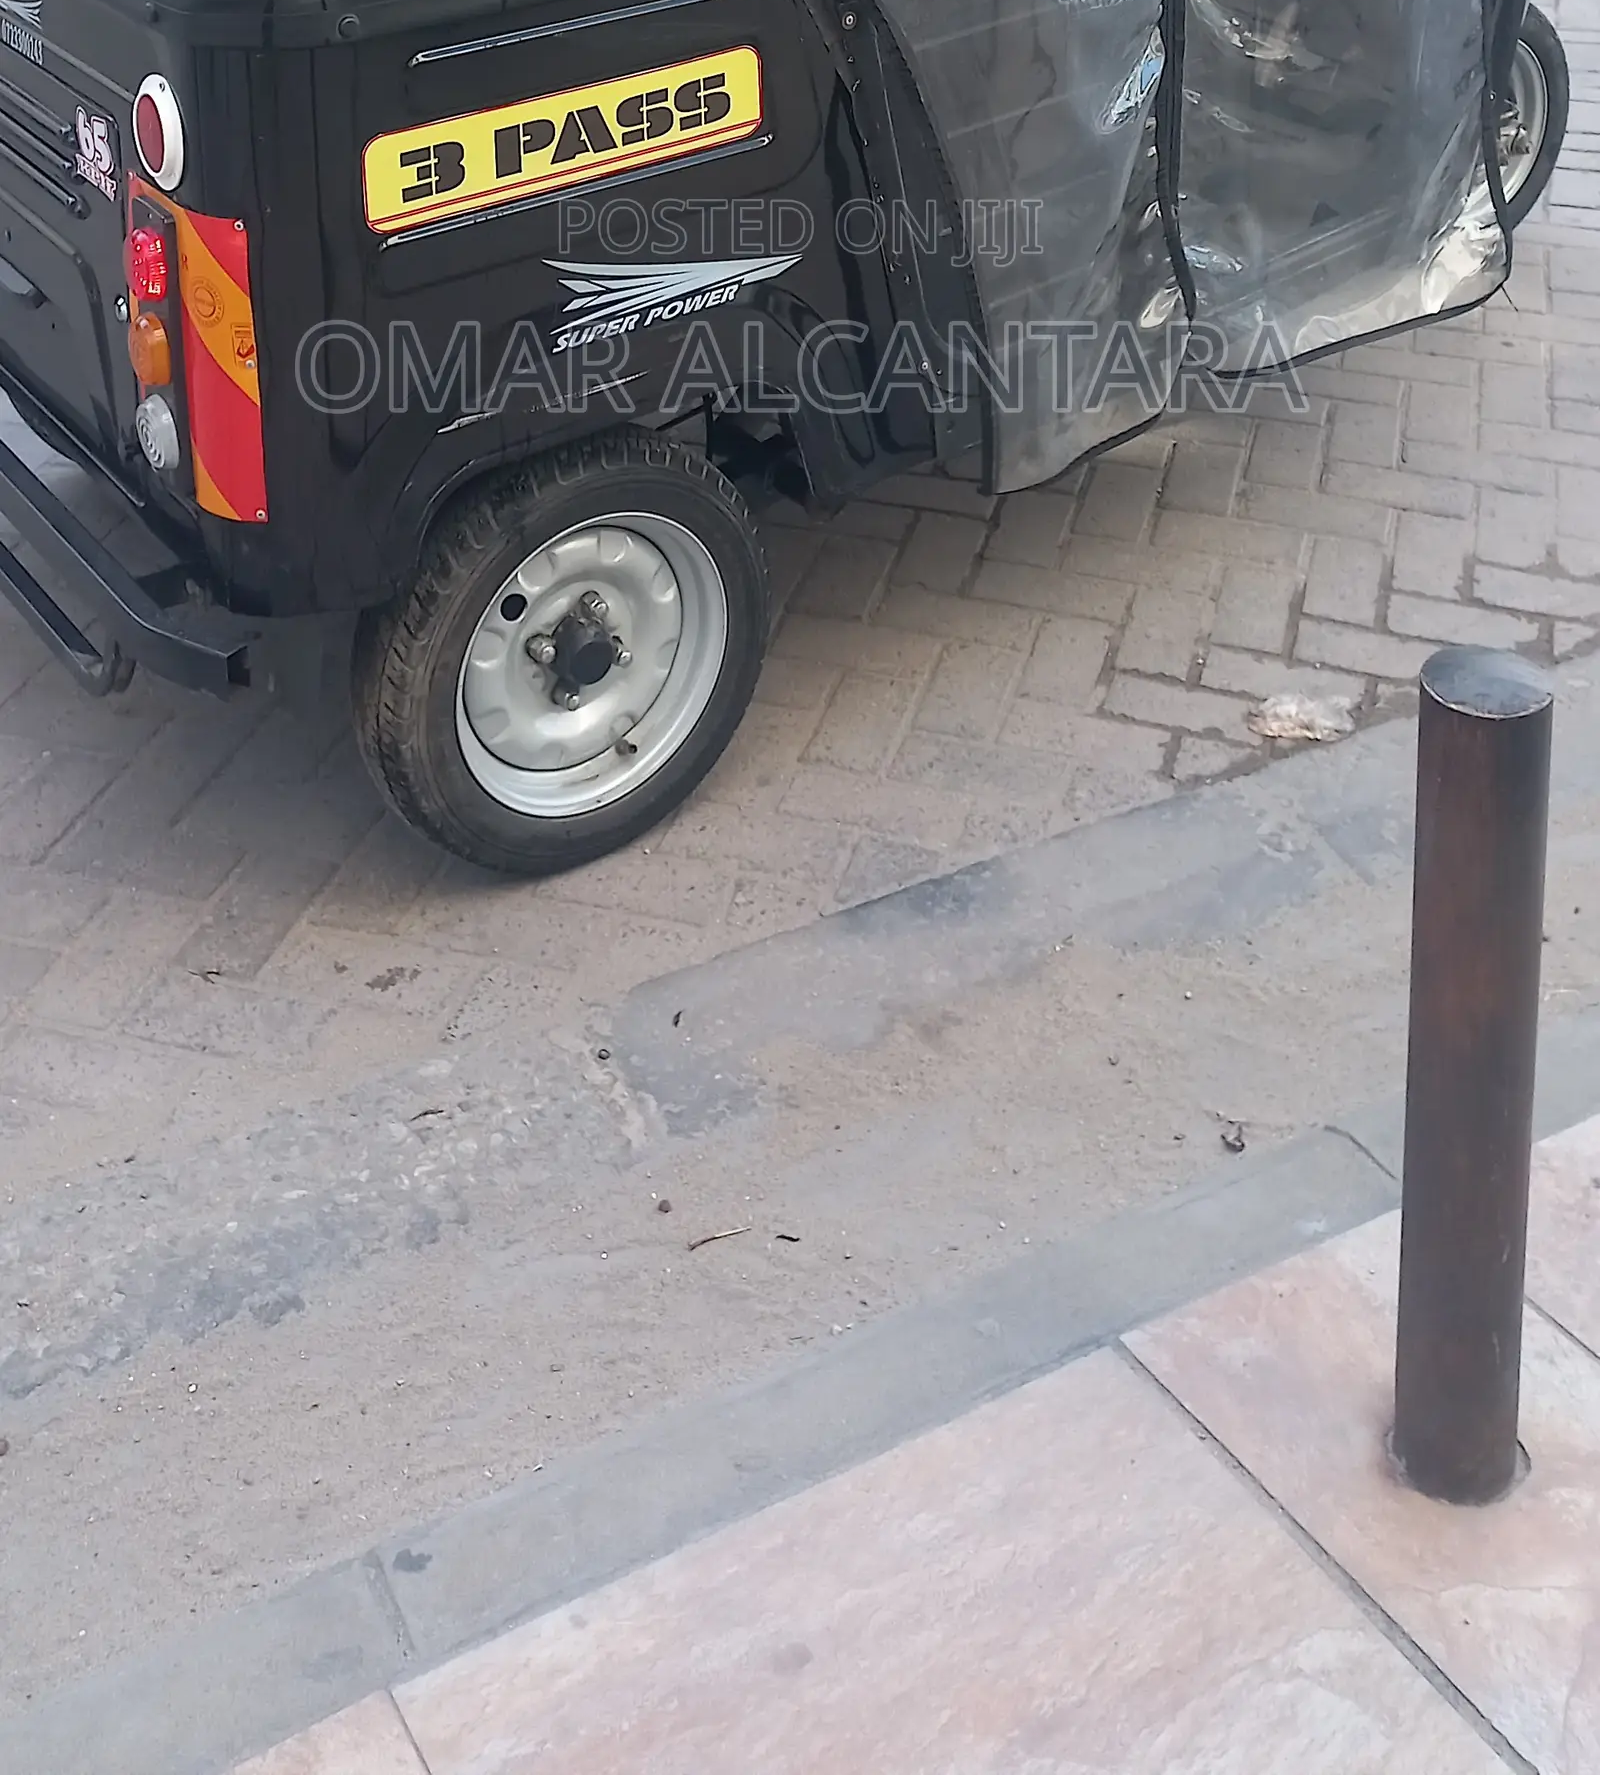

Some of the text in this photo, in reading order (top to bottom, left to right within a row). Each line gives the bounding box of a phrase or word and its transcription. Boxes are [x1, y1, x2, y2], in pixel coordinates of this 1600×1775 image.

[76, 106, 114, 176] 65
[399, 72, 732, 204] 3 PASS
[552, 283, 740, 354] SUPER POWER
